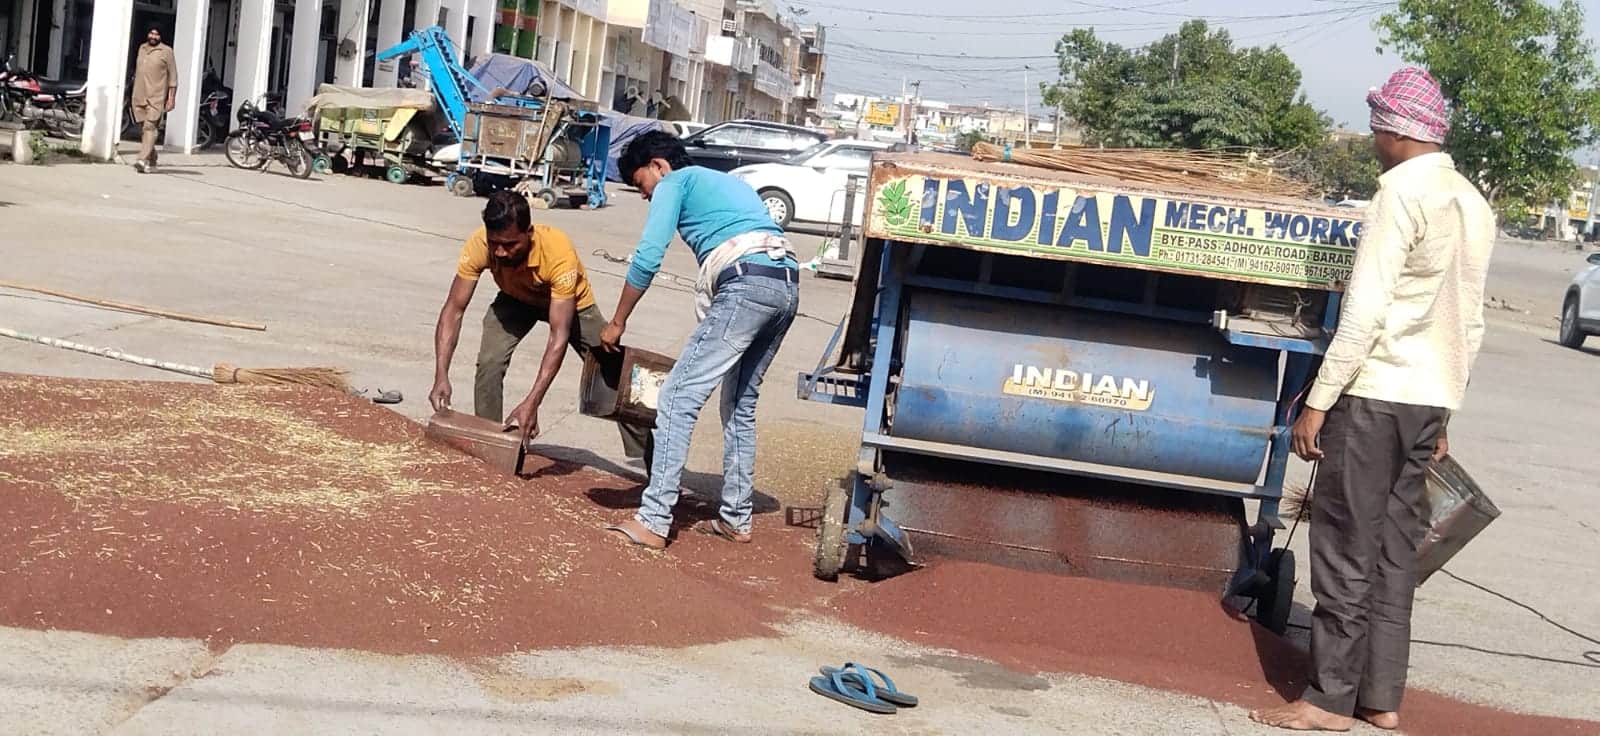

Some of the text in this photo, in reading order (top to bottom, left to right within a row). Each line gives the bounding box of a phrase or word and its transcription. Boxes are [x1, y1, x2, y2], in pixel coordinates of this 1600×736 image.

[919, 176, 1157, 257] INDIAN
[1164, 200, 1254, 236] MECH.
[1224, 241, 1271, 256] ADHOYA
[1313, 250, 1354, 266] BARAR
[1012, 364, 1149, 401] INDIAN
[1028, 388, 1047, 397] (M)
